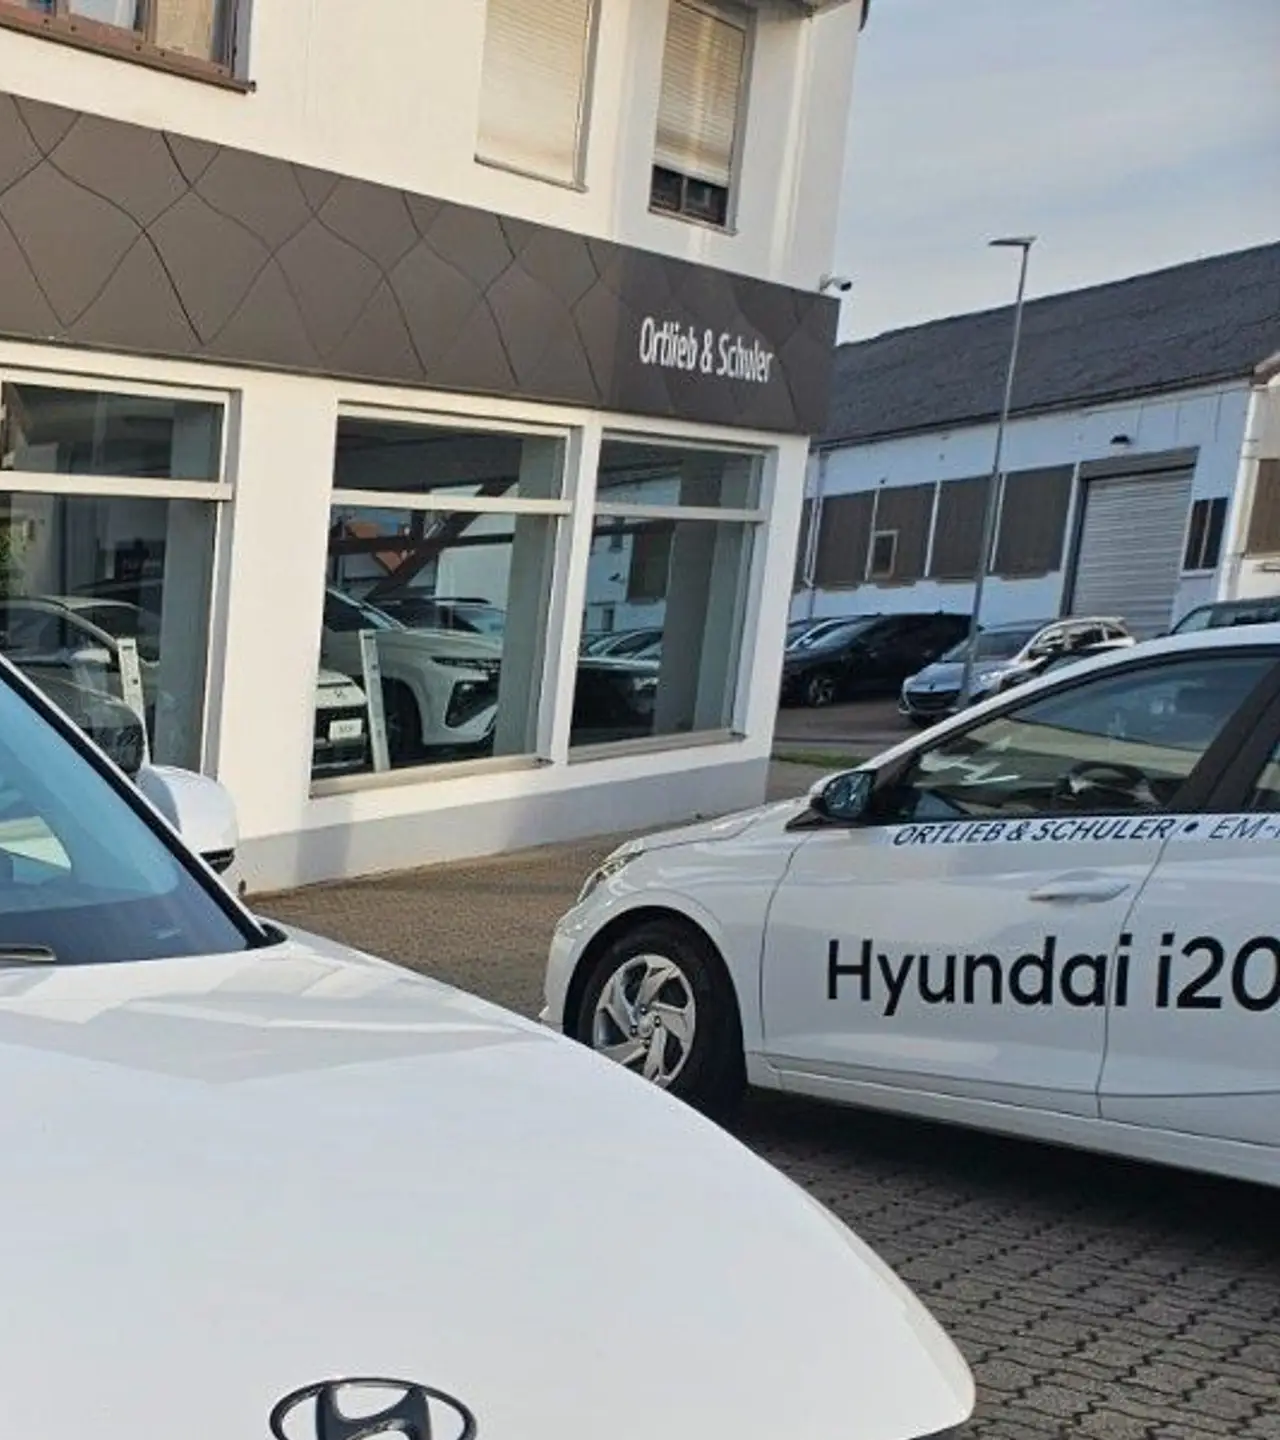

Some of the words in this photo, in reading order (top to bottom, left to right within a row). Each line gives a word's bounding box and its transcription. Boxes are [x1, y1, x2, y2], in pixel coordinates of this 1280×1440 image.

[639, 316, 698, 371] Ortlieb
[700, 329, 713, 374] &
[716, 333, 774, 383] Schuler
[893, 822, 1003, 845] ORTLIEB
[1006, 821, 1032, 842] &
[1031, 817, 1176, 842] SCHULER
[827, 933, 1133, 1016] Hyundai
[1155, 932, 1280, 1012] i20
